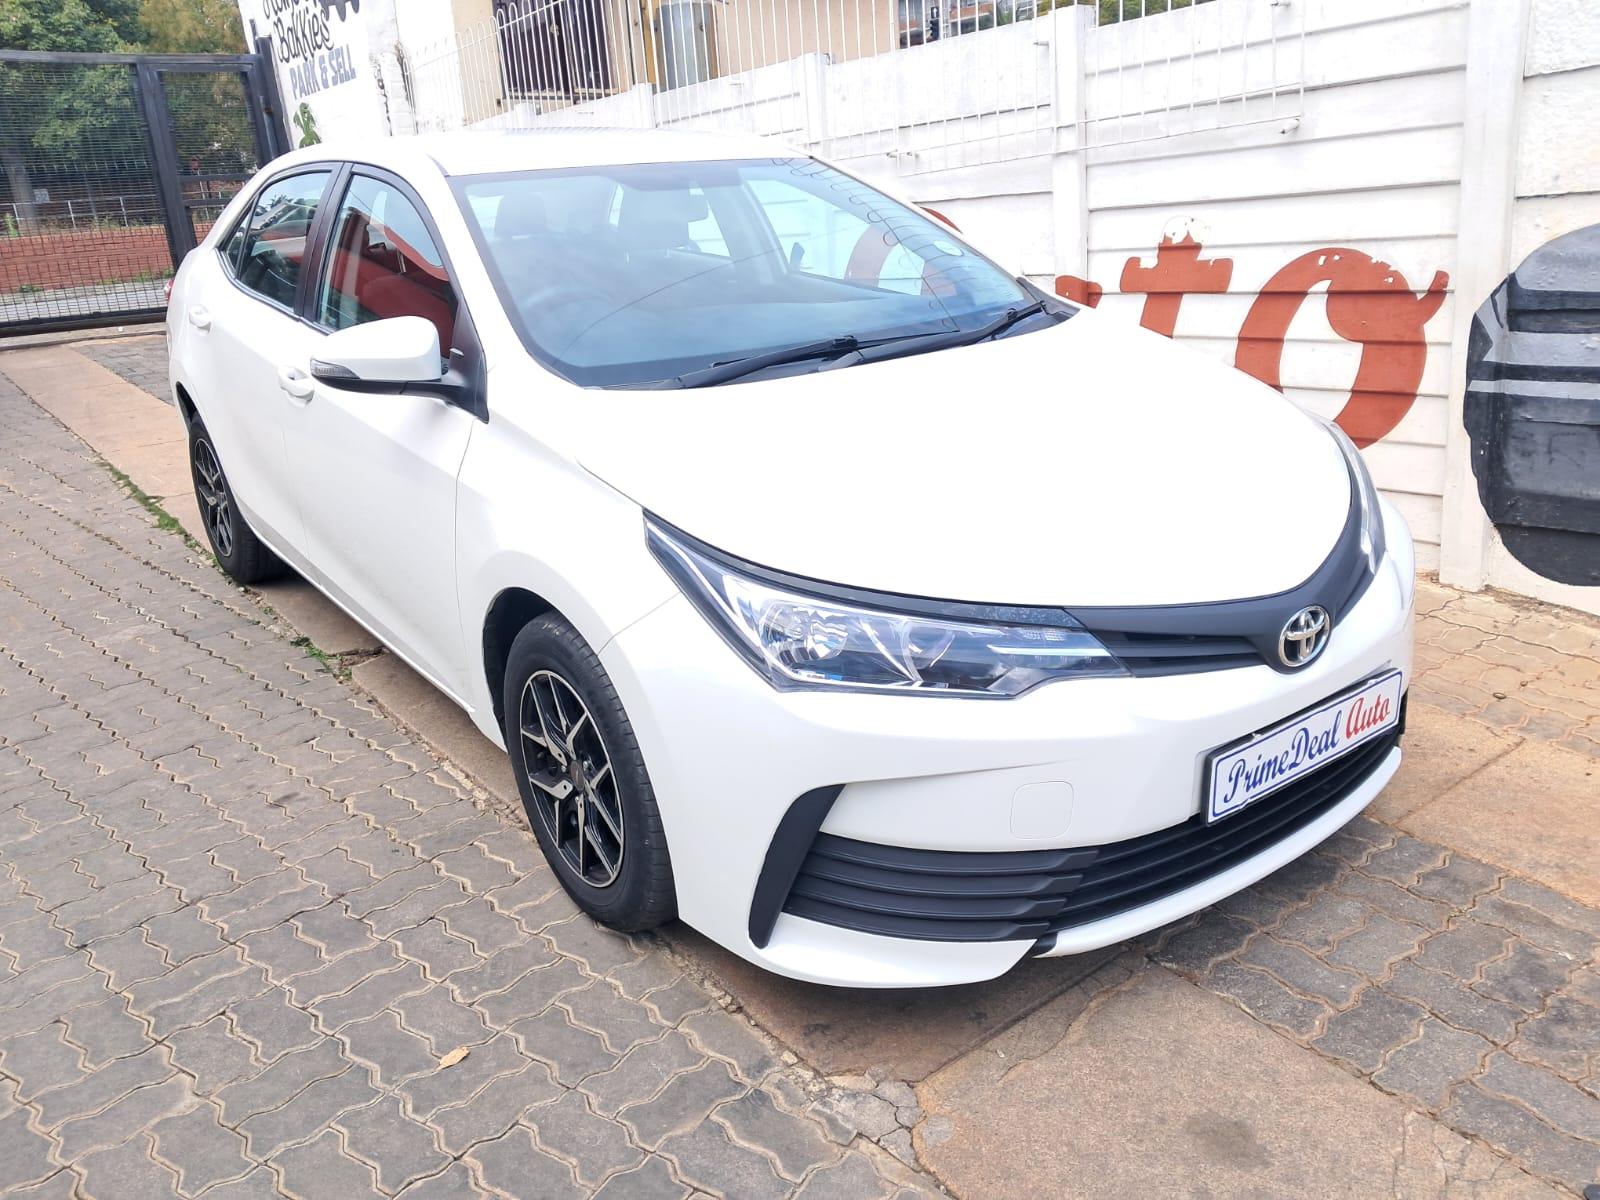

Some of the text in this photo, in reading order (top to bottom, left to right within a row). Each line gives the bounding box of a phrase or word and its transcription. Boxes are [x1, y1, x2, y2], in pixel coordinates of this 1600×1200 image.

[290, 45, 357, 99] PARK & SELL
[1224, 694, 1391, 804] PrimeDeal Auto
